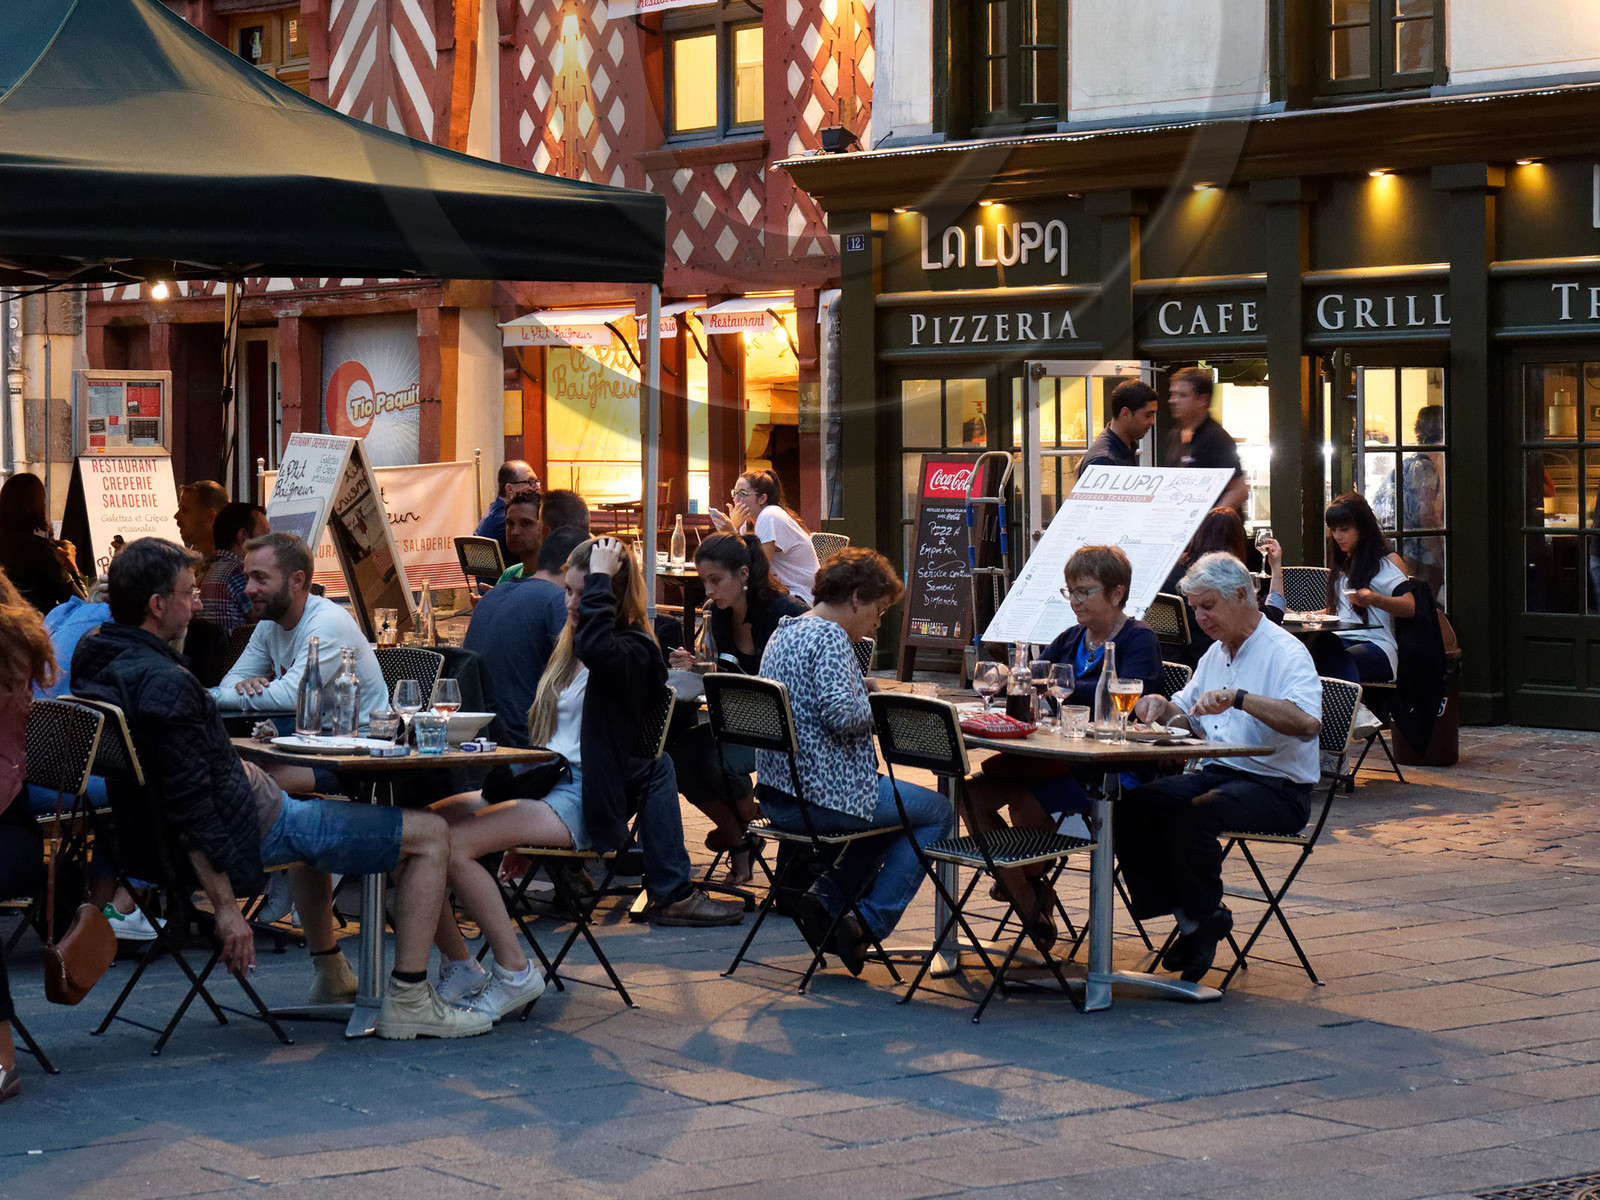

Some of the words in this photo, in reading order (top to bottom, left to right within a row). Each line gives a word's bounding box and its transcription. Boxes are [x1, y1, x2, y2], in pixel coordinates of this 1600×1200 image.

[850, 236, 861, 249] 12
[921, 215, 966, 270] LA
[975, 219, 1069, 276] LUPA
[1158, 301, 1258, 335] CAFE
[1316, 294, 1451, 330] GRILL
[709, 314, 765, 328] Restaurant
[910, 311, 1079, 346] PIZZERIA
[553, 325, 593, 342] Baigneur
[350, 396, 374, 420] Tio
[91, 459, 158, 473] RESTAURANT
[102, 476, 153, 491] CREPERIE
[1080, 468, 1110, 490] LA
[1110, 474, 1164, 496] LUPA
[102, 494, 159, 508] SALADERIE
[1072, 492, 1105, 500] PIZZERIA
[1107, 494, 1147, 502] TRATTORIA
[101, 513, 133, 523] Galettes
[135, 514, 143, 522] et
[116, 523, 157, 533] artisanales
[403, 536, 452, 553] SALADERIE
[926, 580, 957, 592] Samedi
